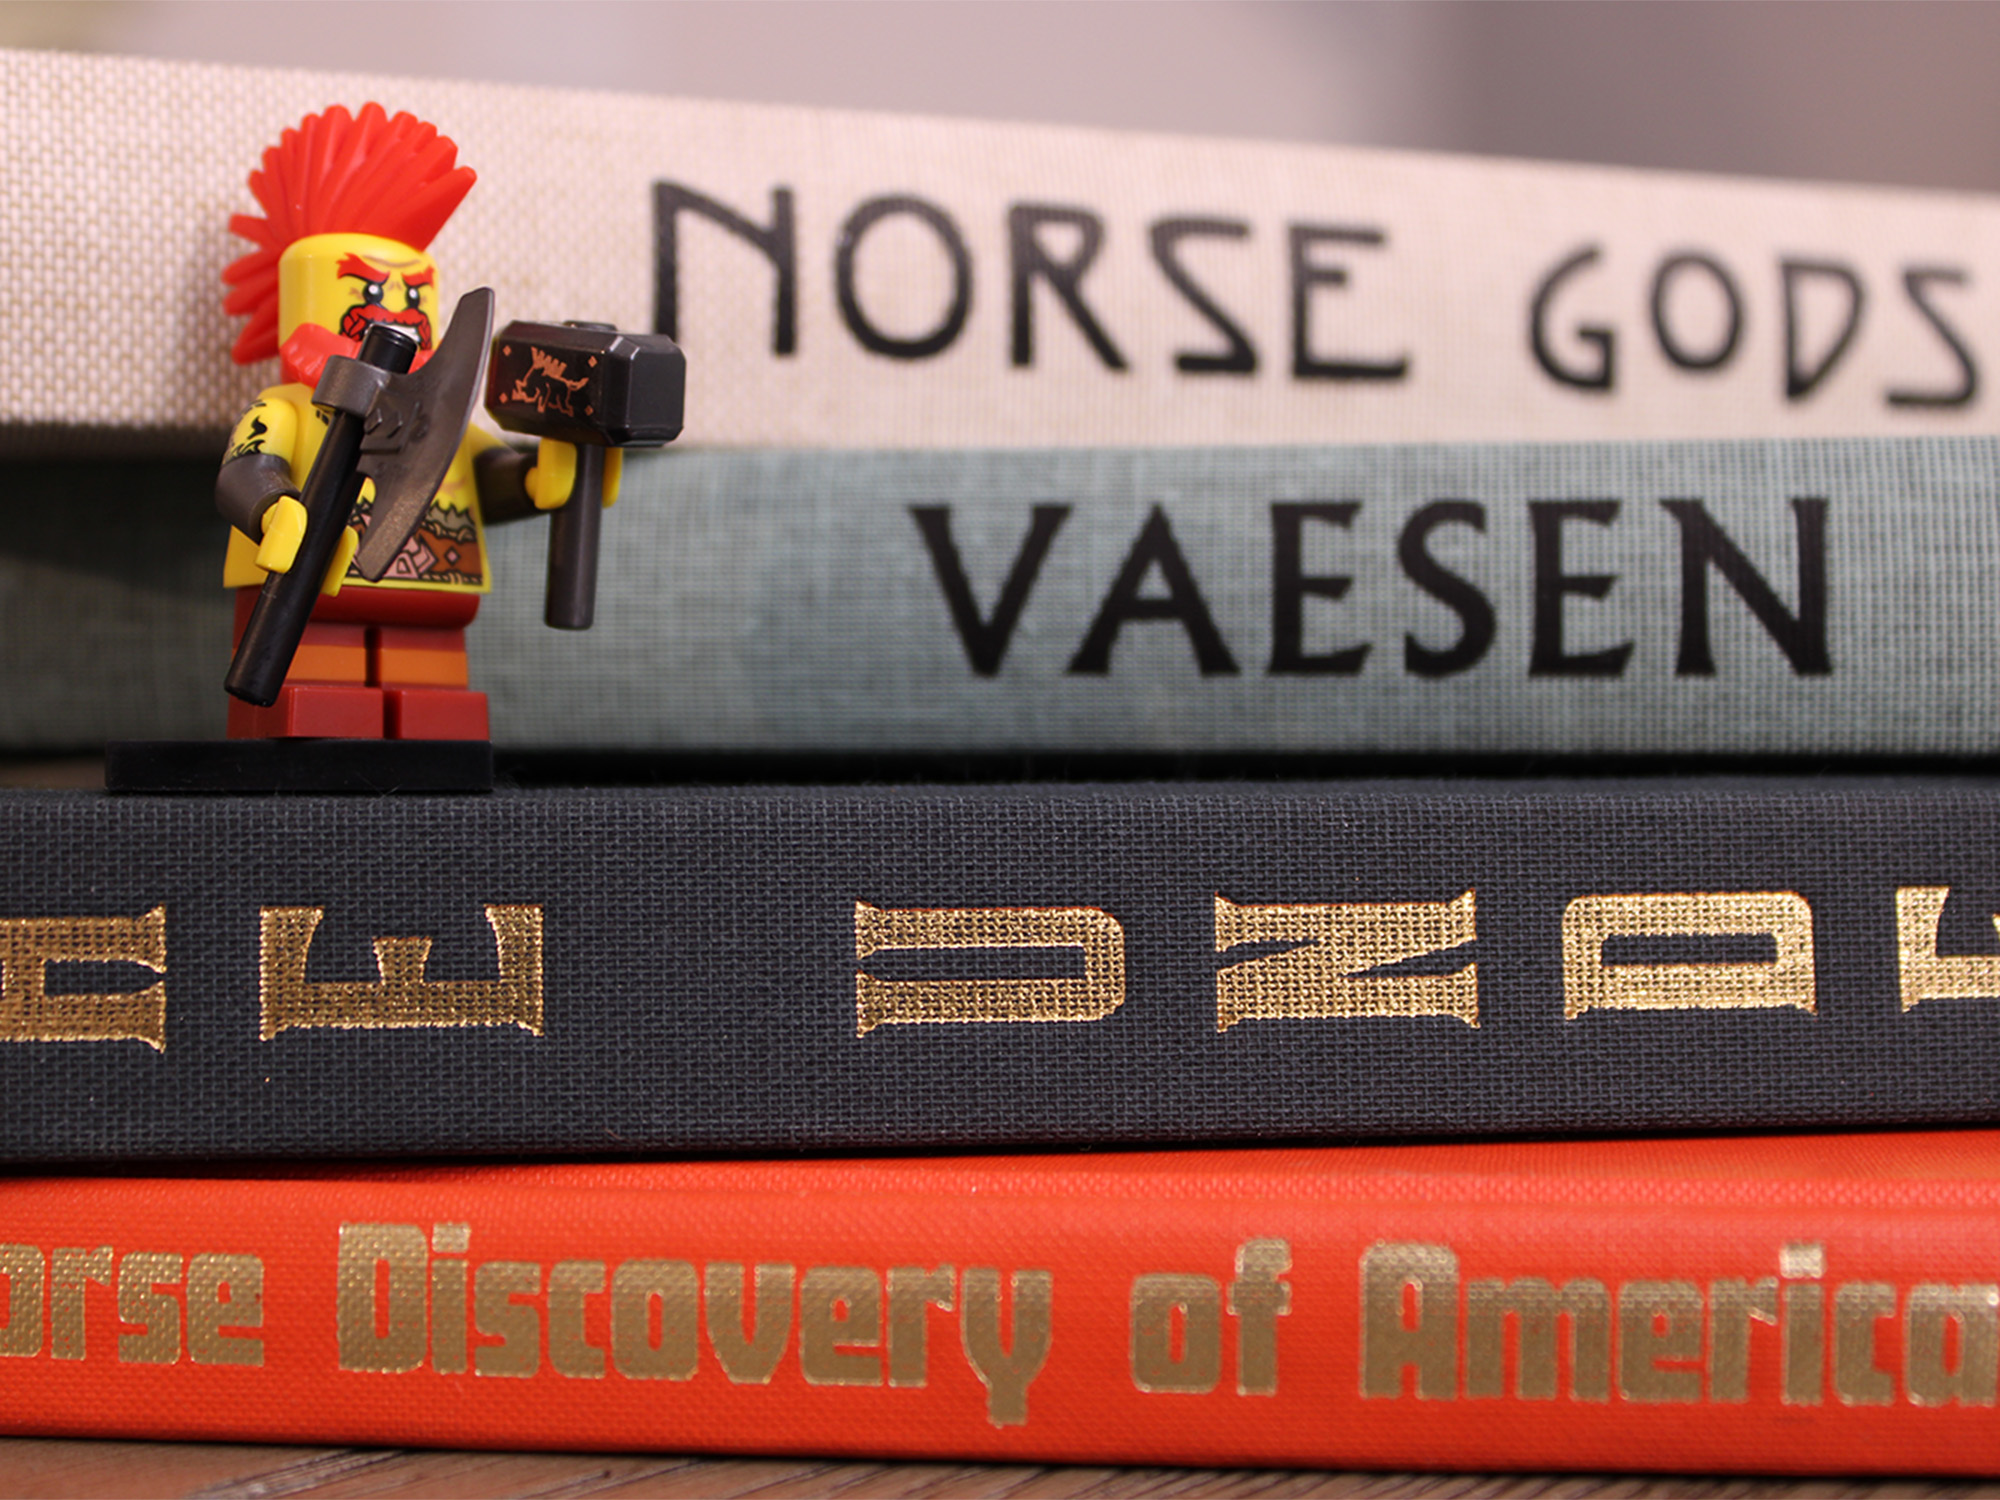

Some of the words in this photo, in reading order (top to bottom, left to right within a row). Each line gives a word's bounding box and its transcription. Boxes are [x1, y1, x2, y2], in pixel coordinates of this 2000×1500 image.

[652, 180, 1409, 383] NORSE
[1527, 243, 1981, 410] GODS
[908, 495, 1833, 680] VAESEN
[337, 1222, 1053, 1428] Discovery
[1129, 1236, 1292, 1398] of
[1359, 1241, 1998, 1407] America
